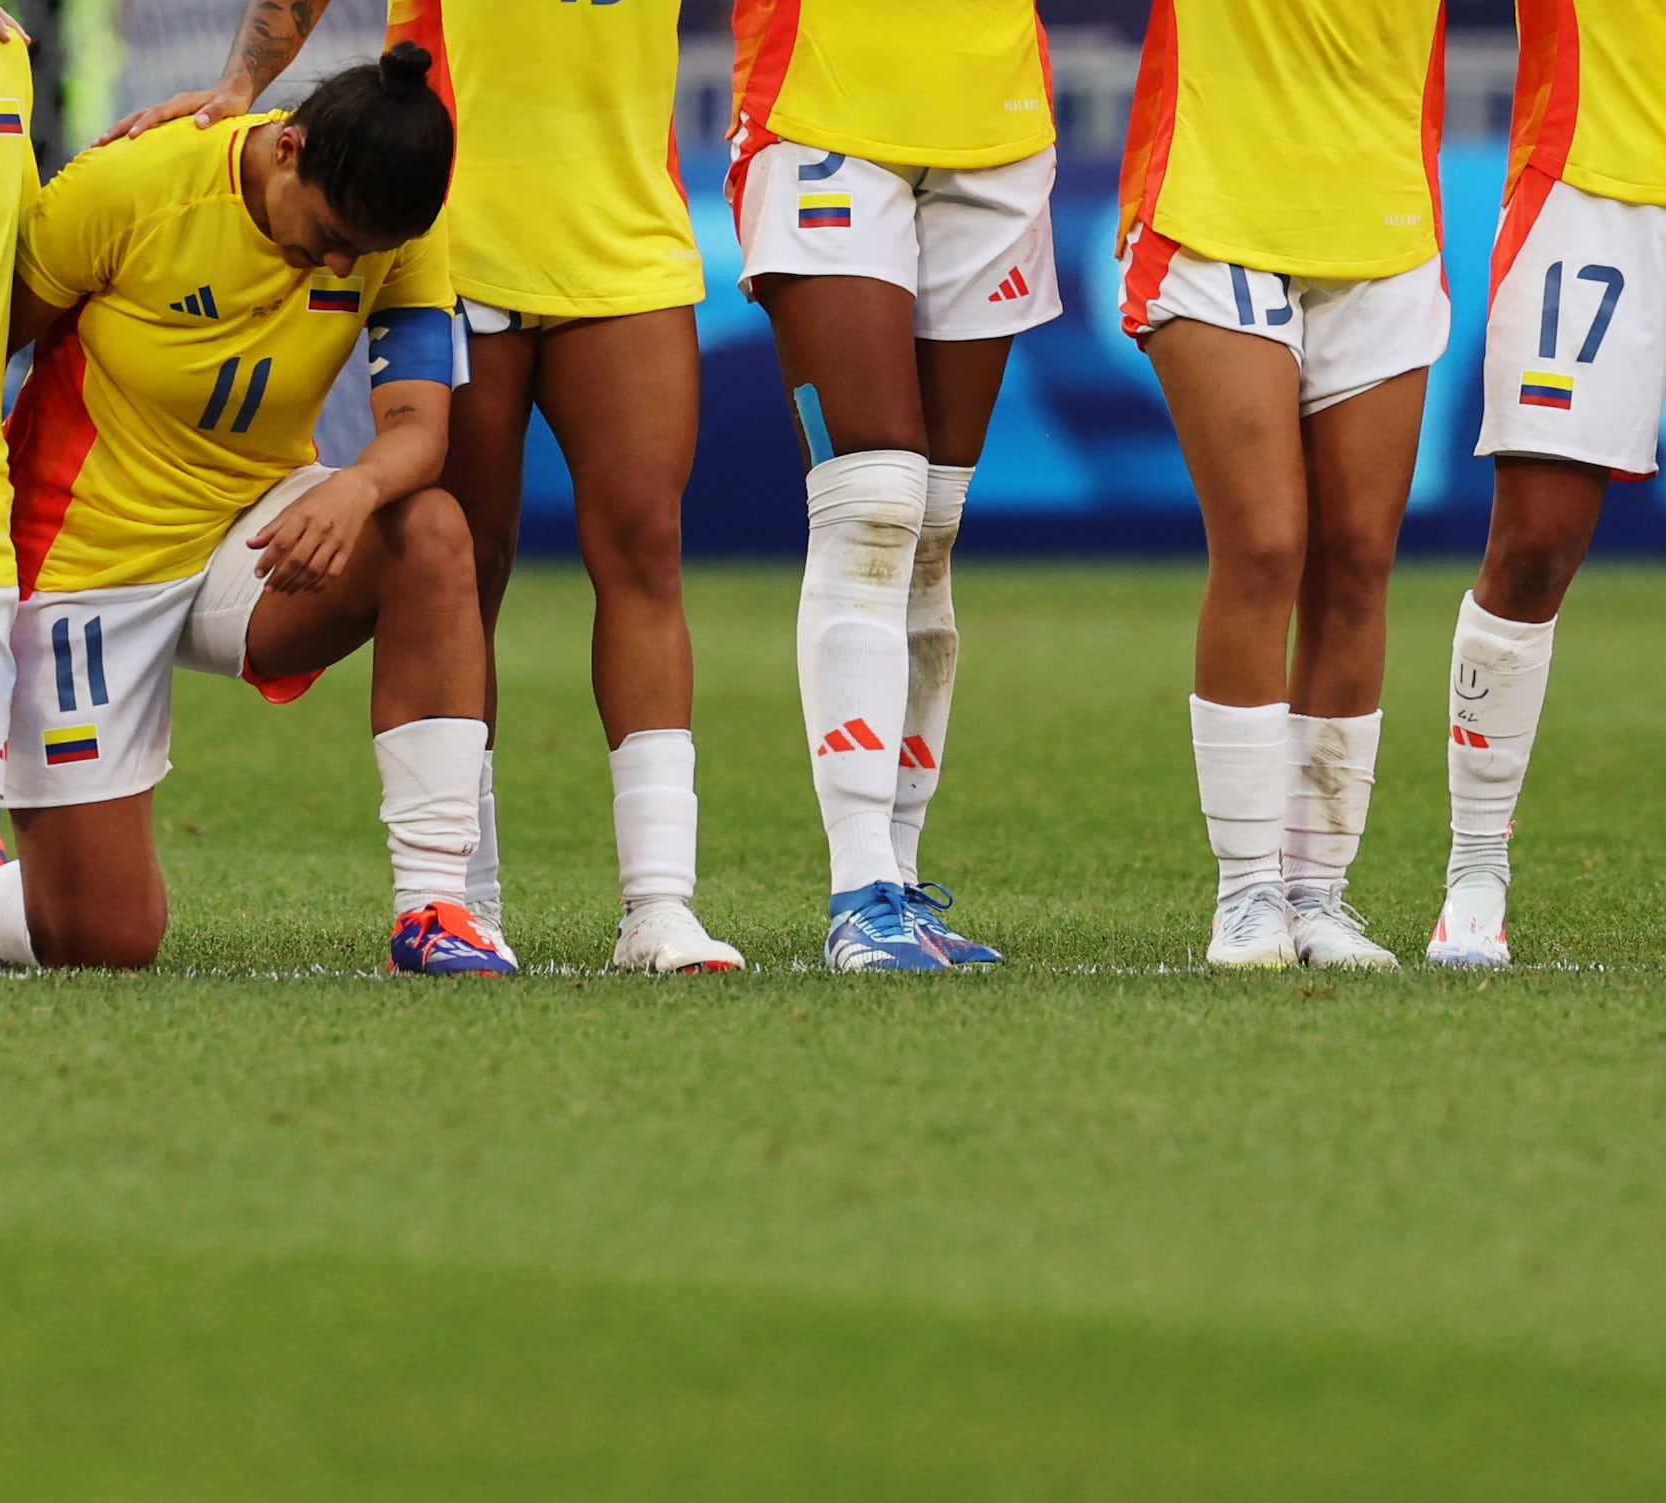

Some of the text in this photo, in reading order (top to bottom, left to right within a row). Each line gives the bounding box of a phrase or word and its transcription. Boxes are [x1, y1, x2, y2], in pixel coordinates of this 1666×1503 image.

[1538, 260, 1625, 364] 17
[198, 356, 271, 434] 11
[51, 615, 109, 713] 11
